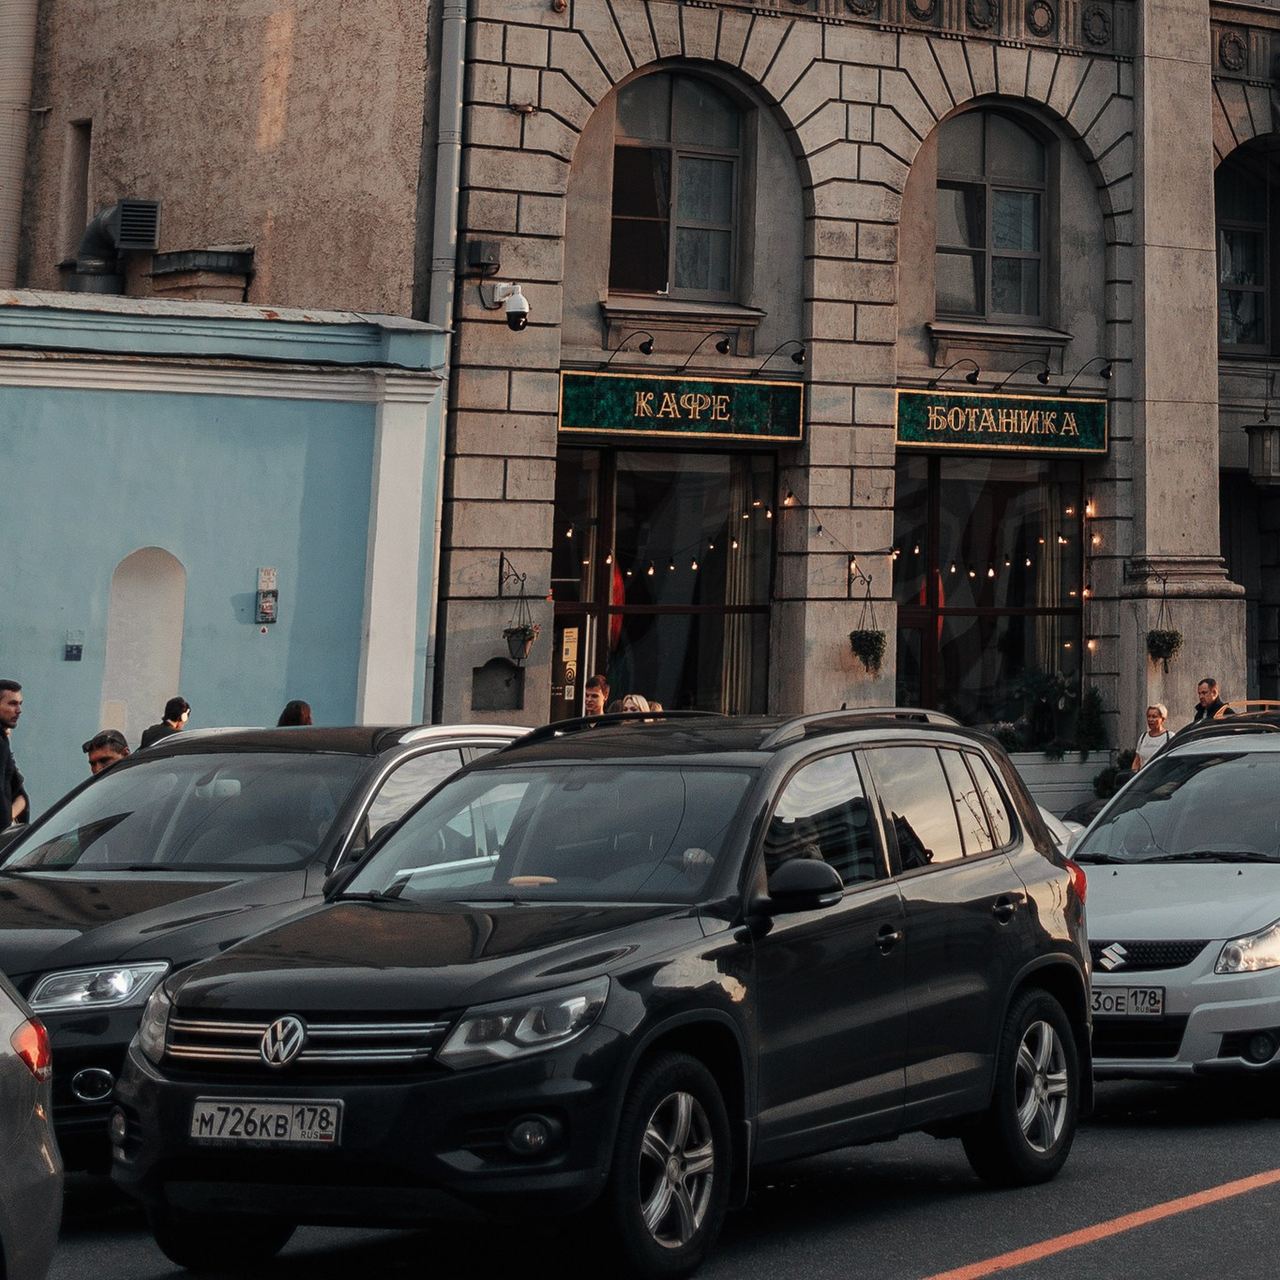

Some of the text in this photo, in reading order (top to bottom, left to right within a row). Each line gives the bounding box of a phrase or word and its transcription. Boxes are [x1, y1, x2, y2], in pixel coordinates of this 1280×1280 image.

[633, 391, 731, 422] КАФЕ
[926, 405, 1080, 436] БОТАНИКА
[1091, 989, 1158, 1012] 3ОЕ 178
[198, 1106, 330, 1137] М726КВ 178
[300, 1130, 319, 1140] RUS
